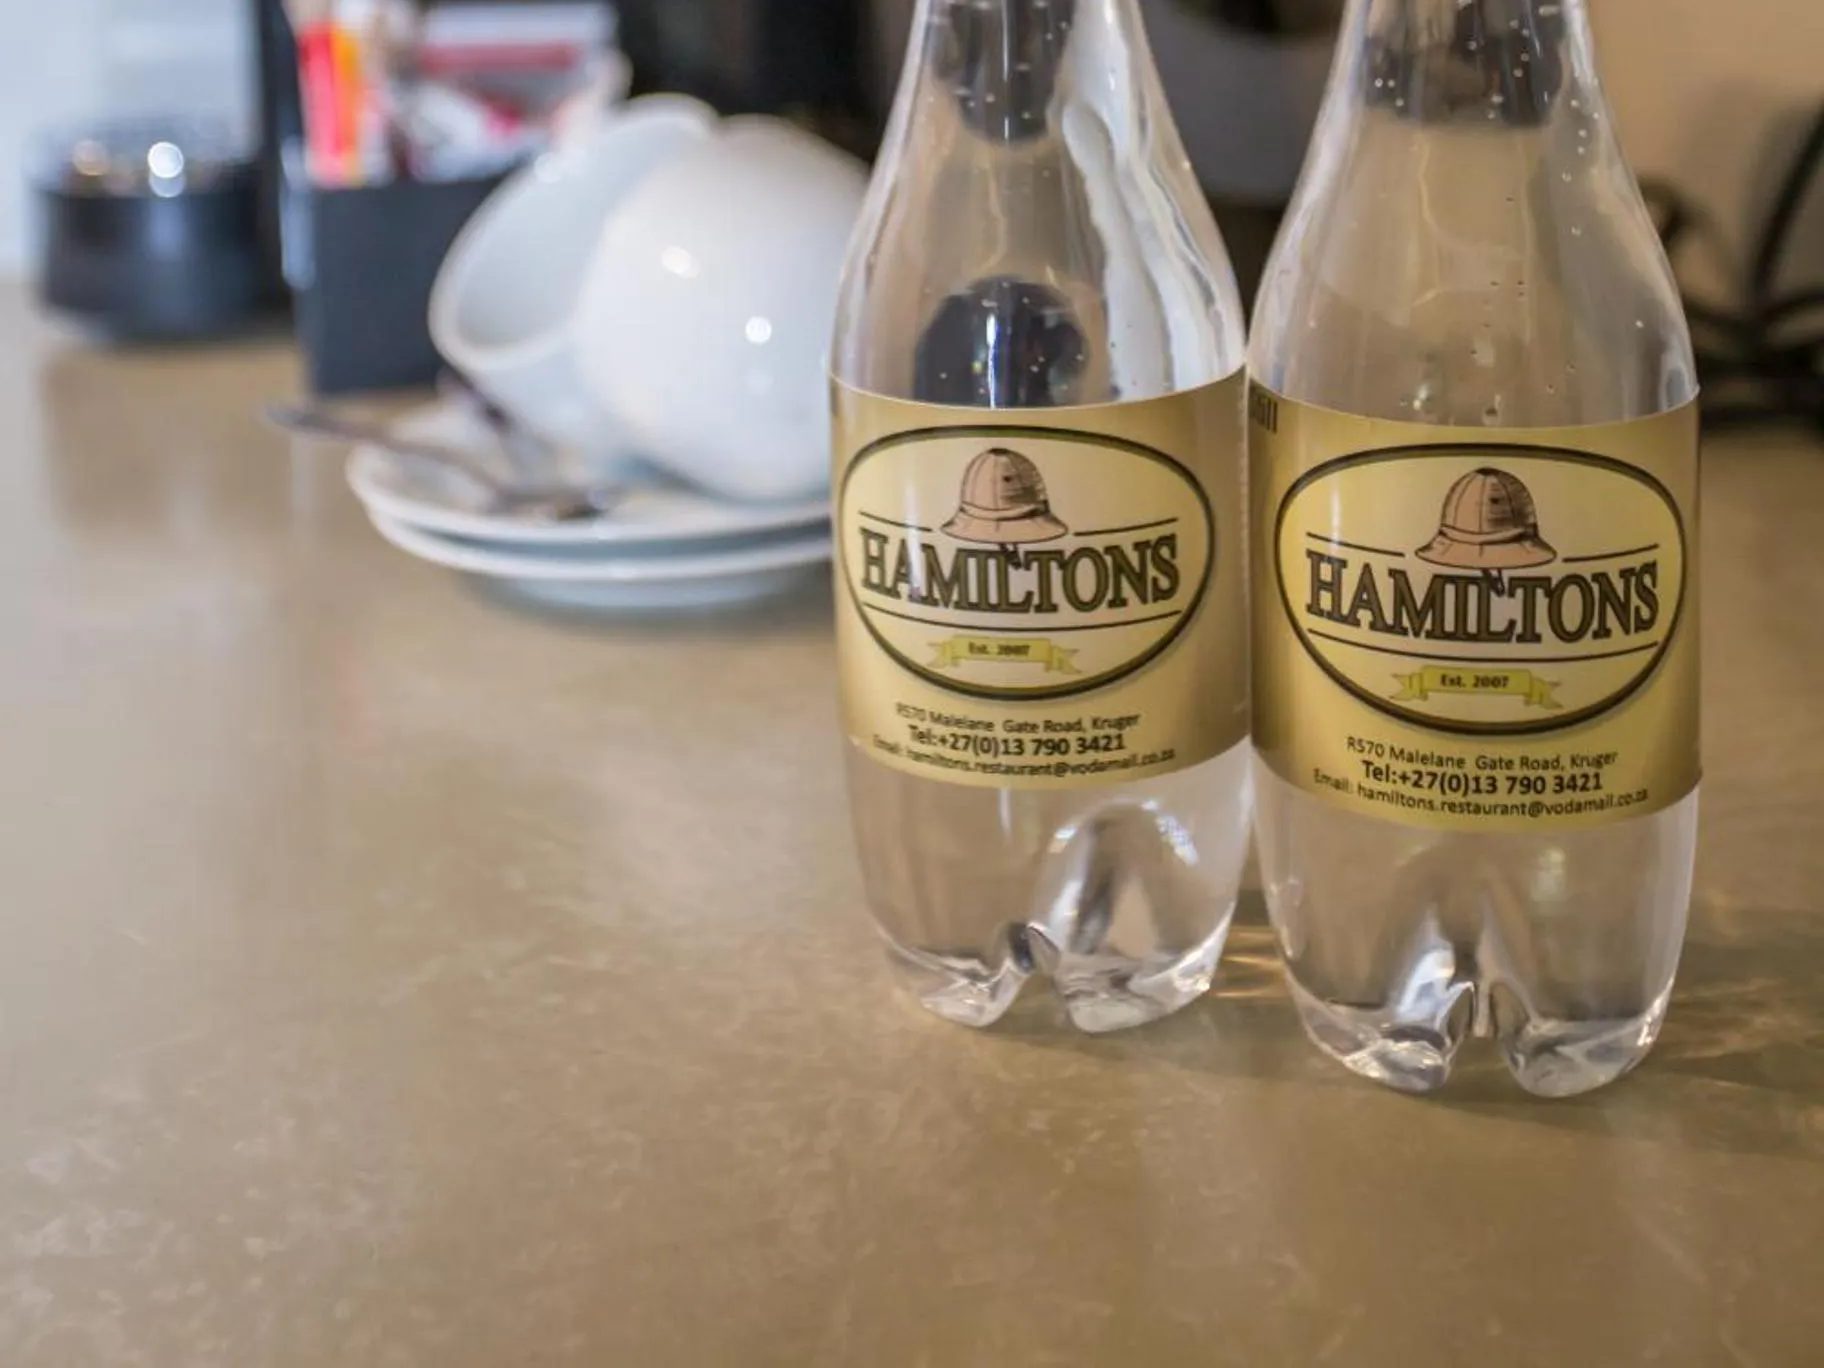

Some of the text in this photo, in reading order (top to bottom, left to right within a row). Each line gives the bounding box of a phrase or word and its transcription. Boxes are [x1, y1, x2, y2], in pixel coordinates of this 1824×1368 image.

[860, 526, 1180, 613] HAMILTONS
[1305, 549, 1659, 644] HAMILTONS
[1440, 673, 1509, 689] Est. 2007
[908, 723, 1126, 759] Tel:+27(0)13 790 3421
[1003, 719, 1041, 733] Gate
[1346, 735, 1619, 771] R570 Malelane Gate Road, Kruger
[1361, 759, 1604, 798] Tel:+27(0)13 790 3421
